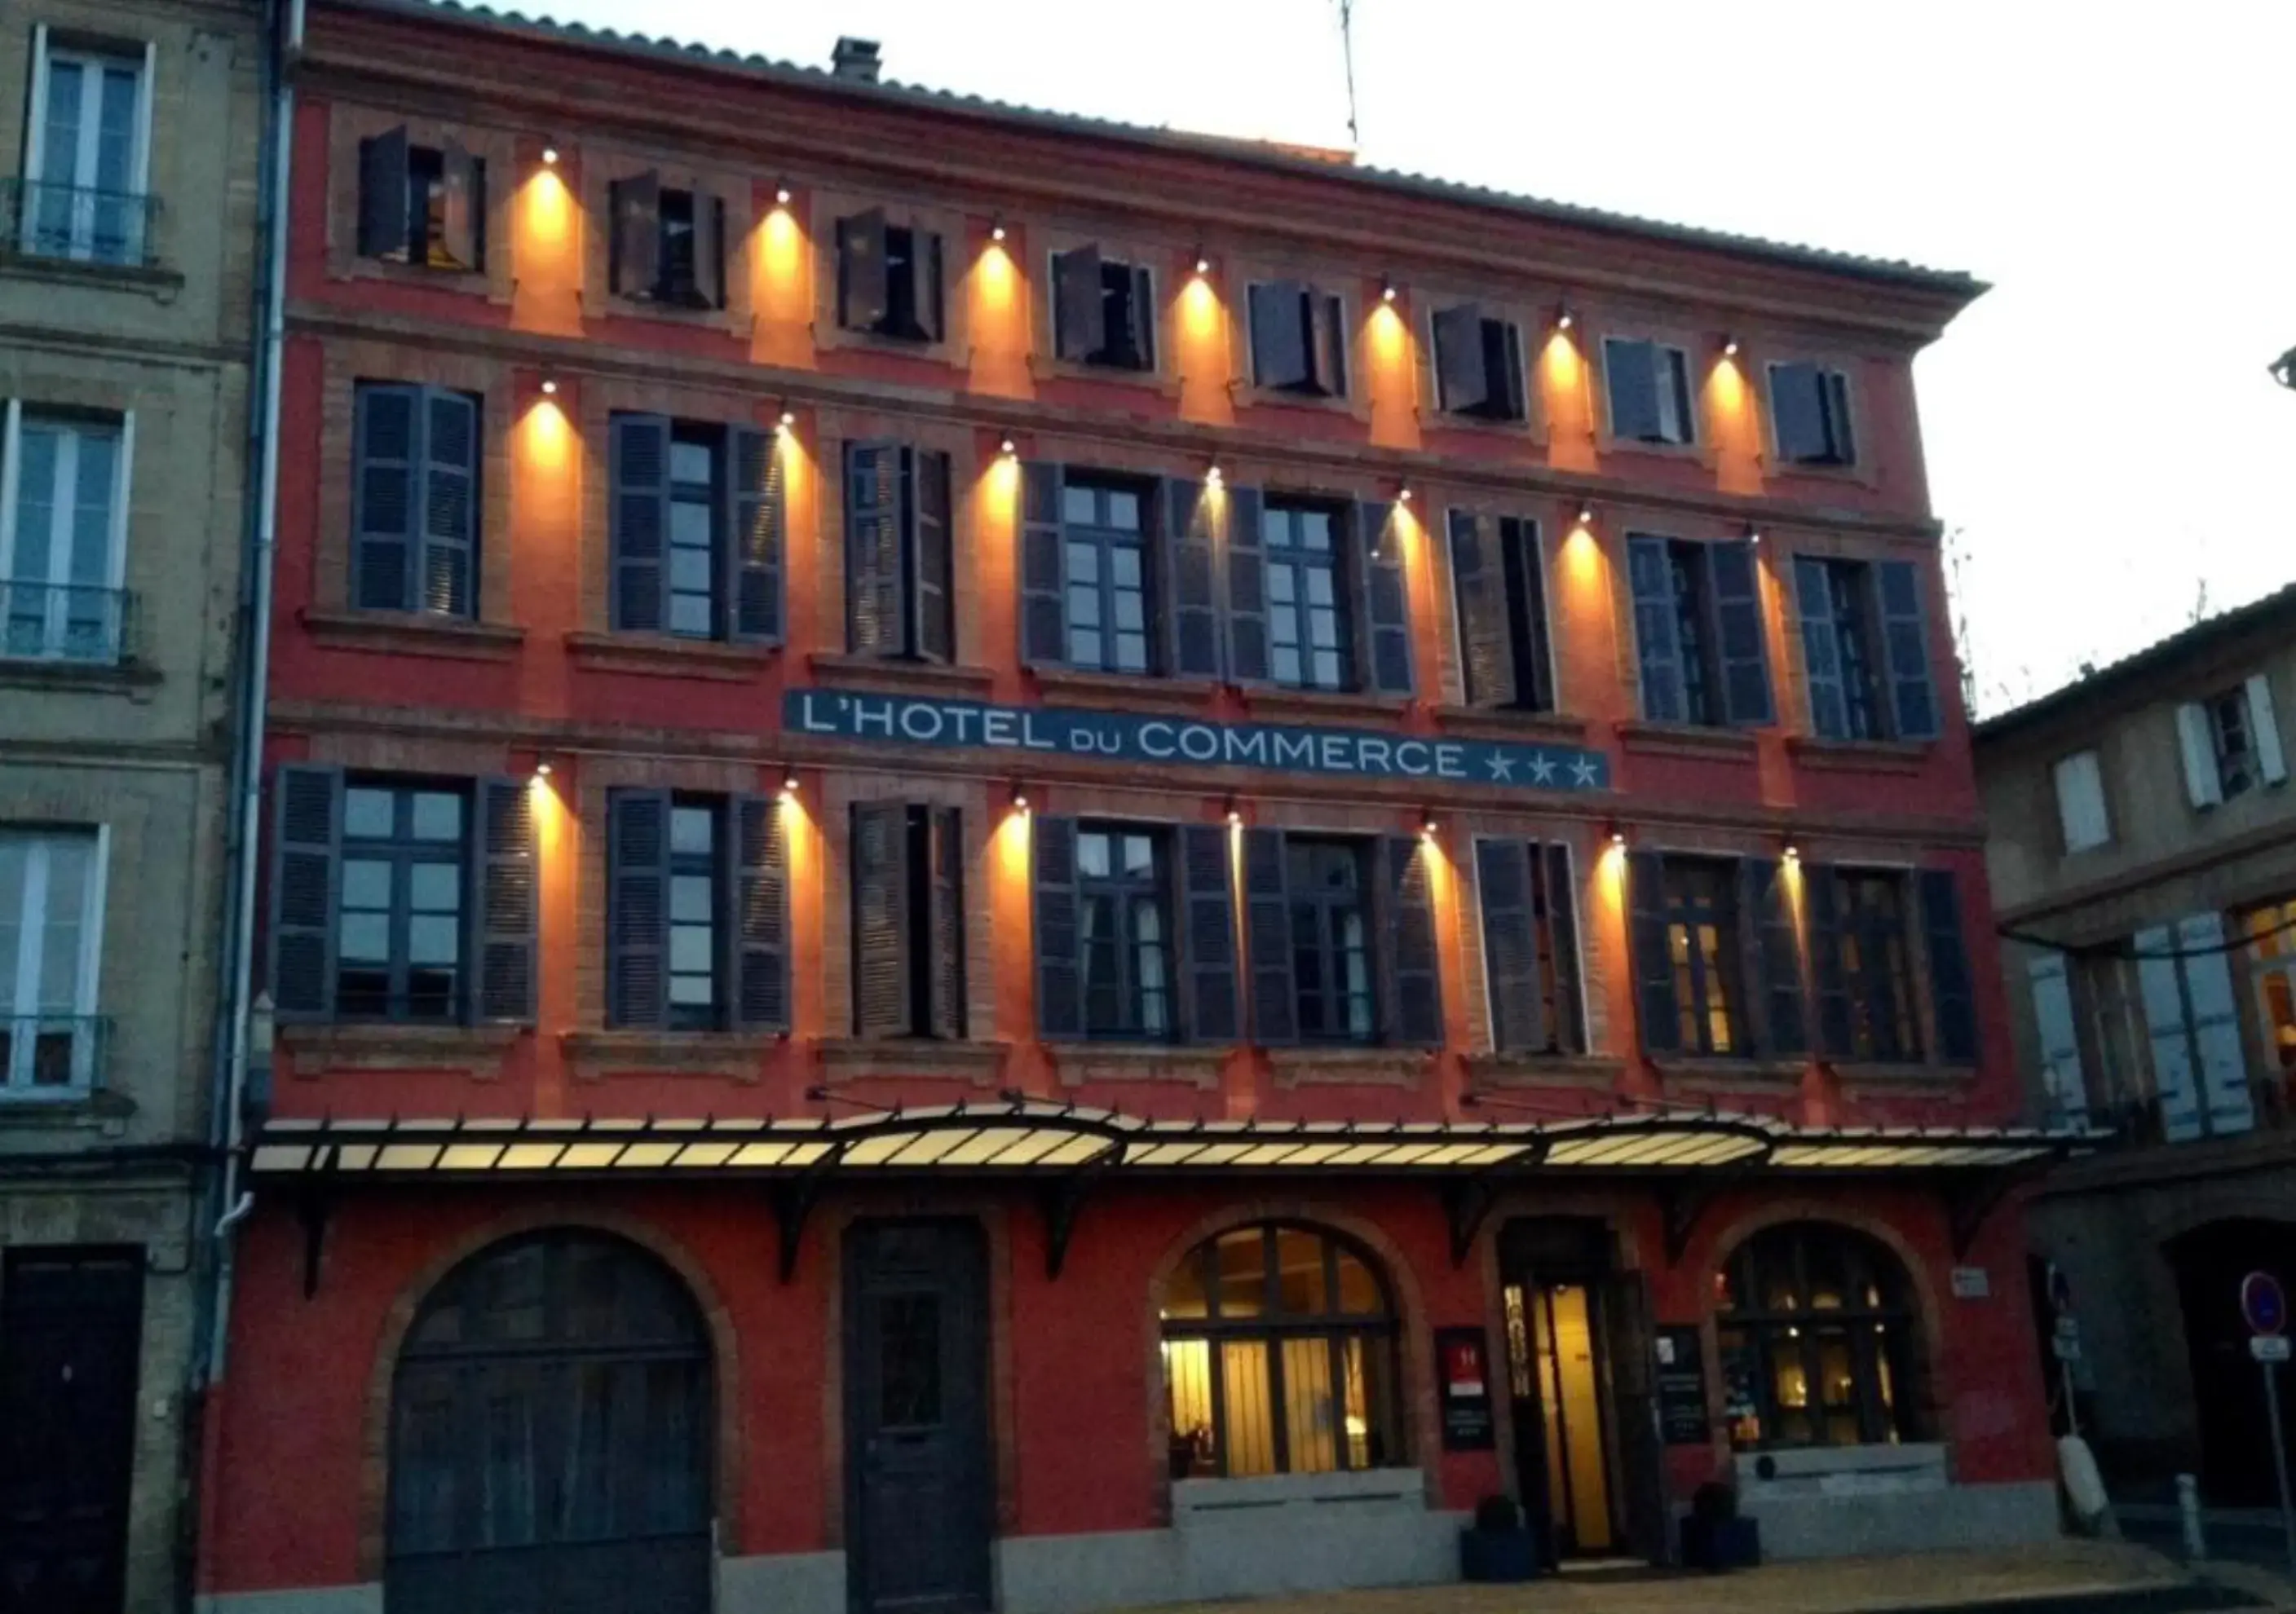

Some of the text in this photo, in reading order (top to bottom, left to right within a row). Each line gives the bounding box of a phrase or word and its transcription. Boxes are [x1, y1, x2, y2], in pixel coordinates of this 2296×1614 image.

[802, 695, 1468, 778] L'HOTEL DU COMMERCE
